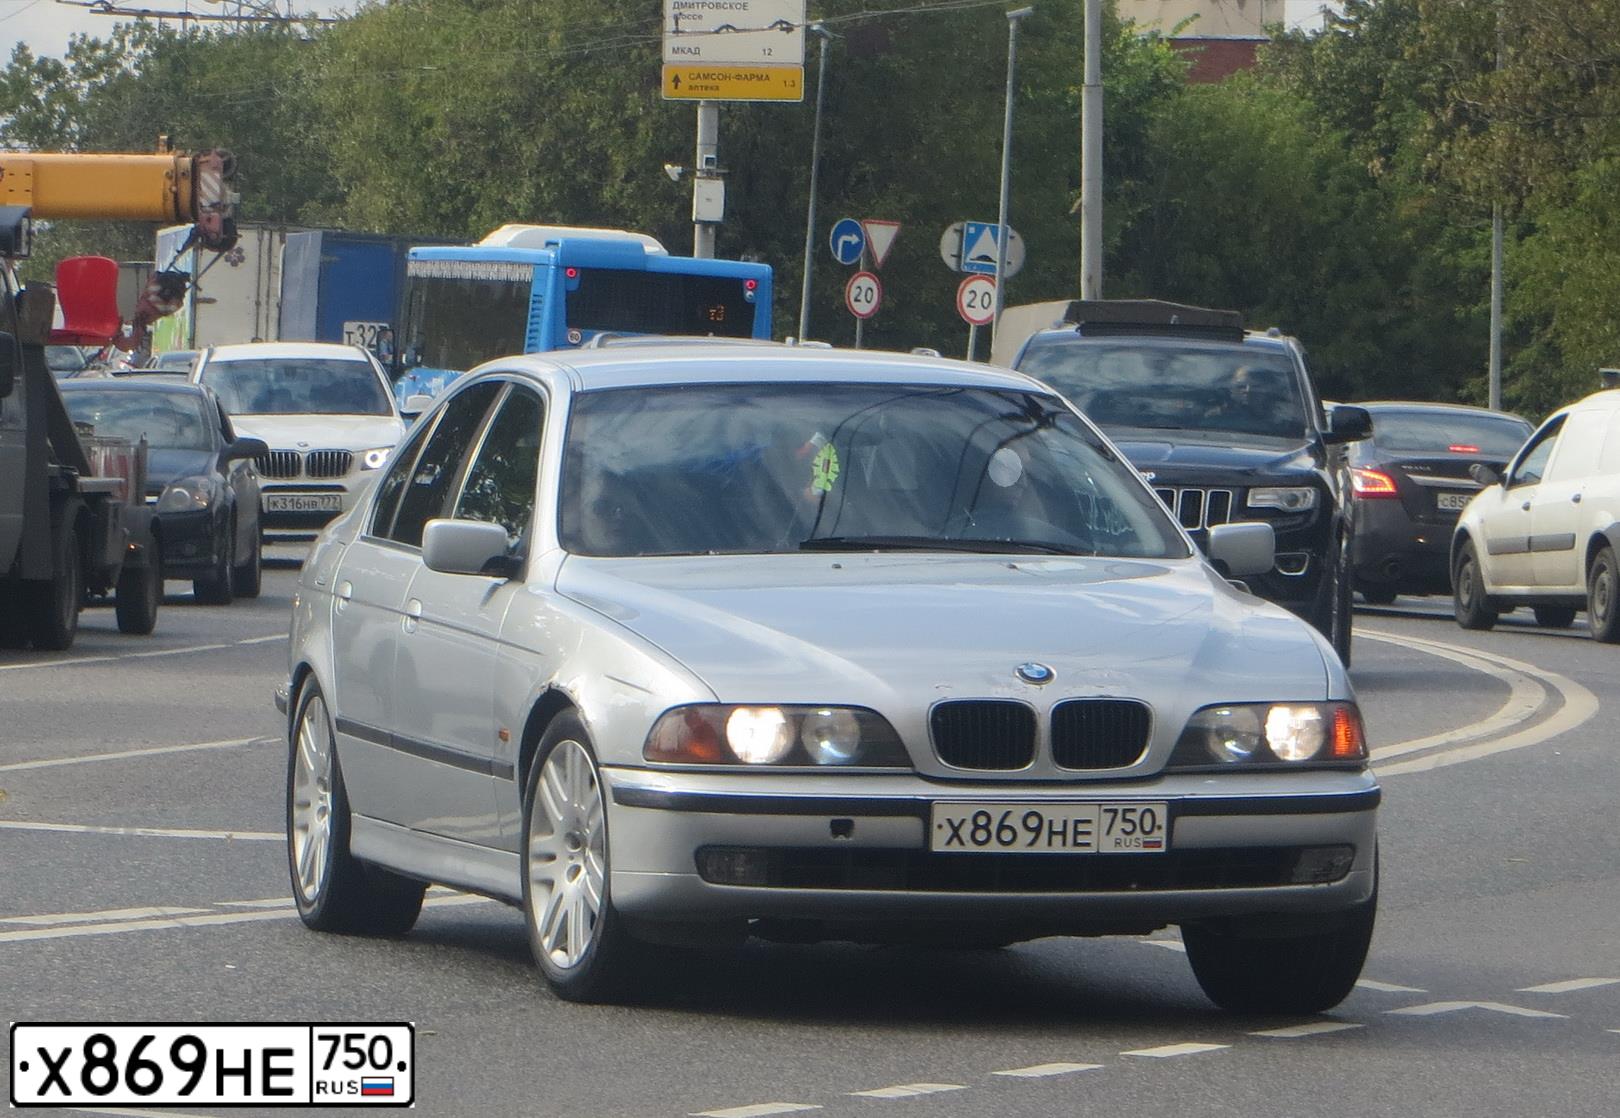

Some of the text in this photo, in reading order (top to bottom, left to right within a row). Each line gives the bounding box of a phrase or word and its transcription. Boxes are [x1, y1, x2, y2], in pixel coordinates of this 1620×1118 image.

[672, 1, 749, 10] ДМИТРОВСКОЕ
[671, 47, 701, 56] МКАД
[762, 48, 773, 56] 12
[688, 73, 771, 82] САМСОН-ФАРМА
[853, 286, 874, 304] 20
[966, 290, 992, 310] 20
[345, 324, 388, 349] Т32
[1103, 808, 1156, 836] 750
[1114, 837, 1141, 848] RUS
